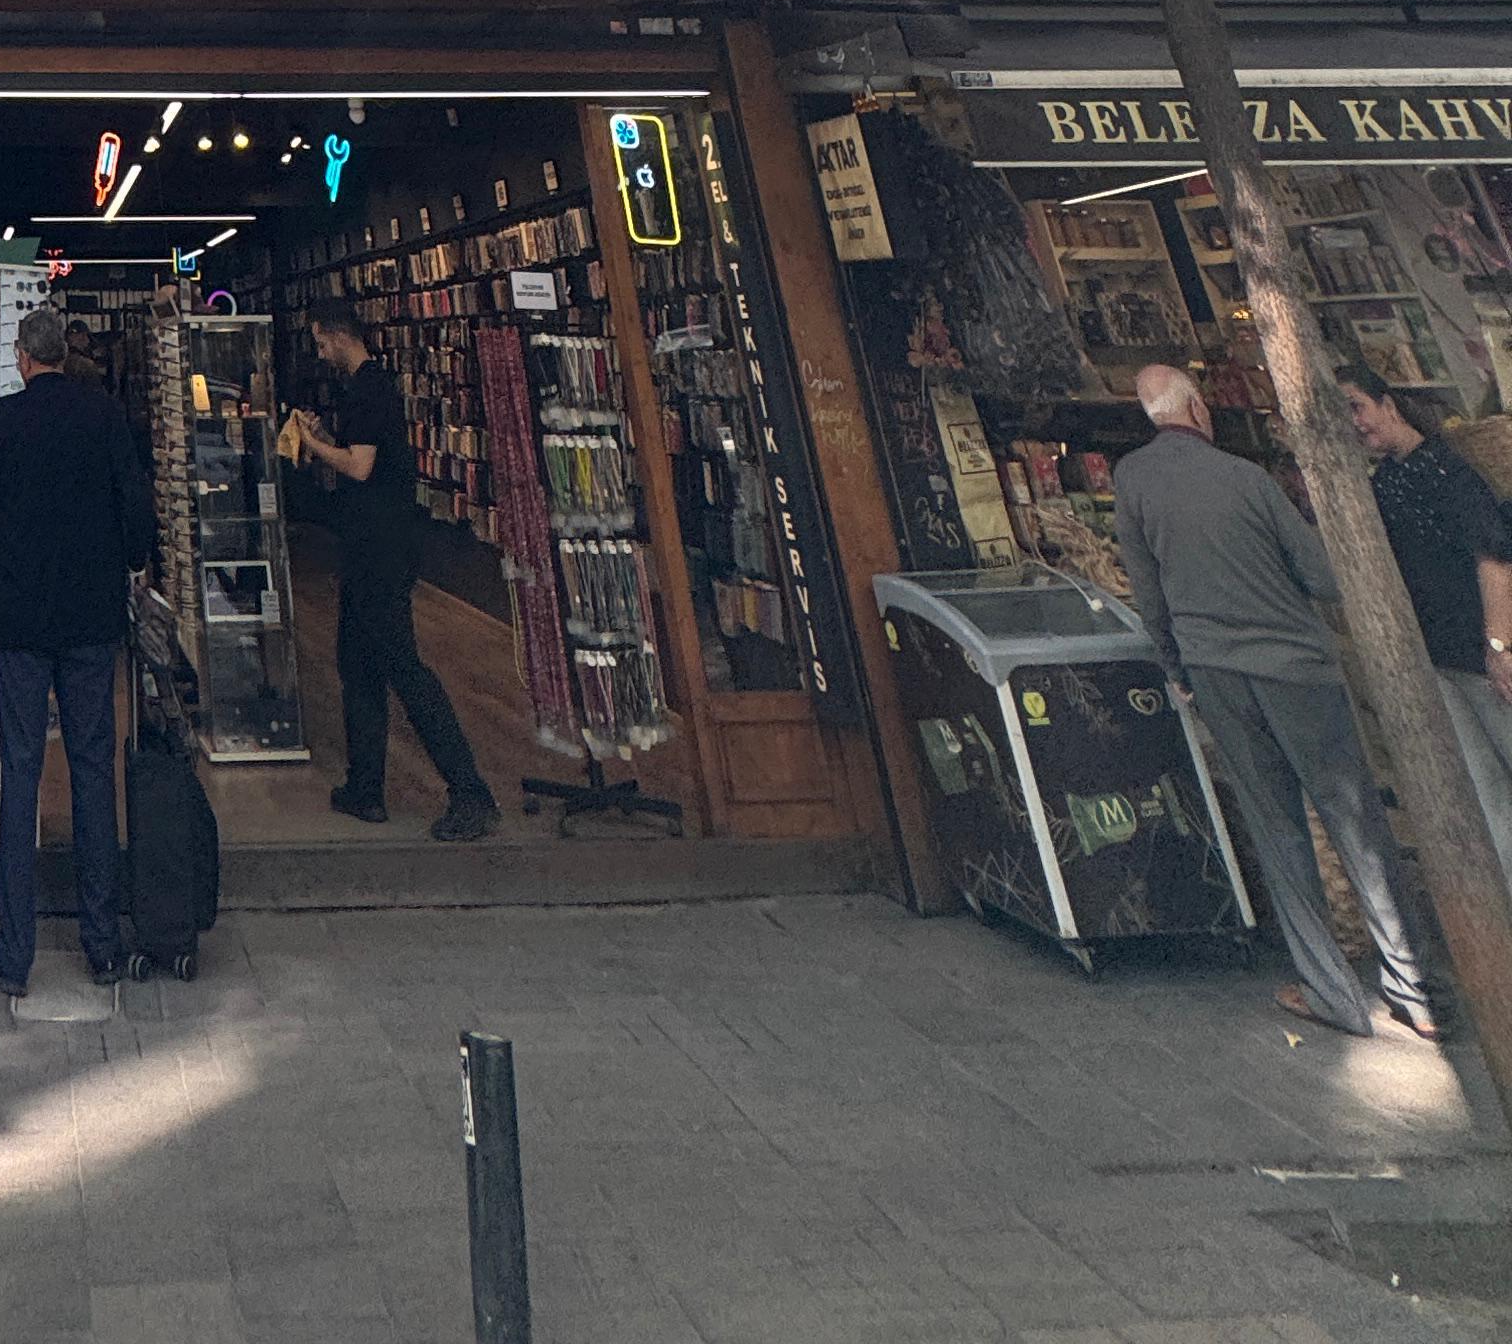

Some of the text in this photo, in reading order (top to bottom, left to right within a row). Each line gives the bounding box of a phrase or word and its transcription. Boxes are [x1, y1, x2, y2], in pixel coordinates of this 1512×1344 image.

[1037, 99, 1328, 144] BELEZA
[729, 263, 778, 453] TEKNİK
[774, 476, 827, 692] SERVİS
[1099, 798, 1128, 826] M
